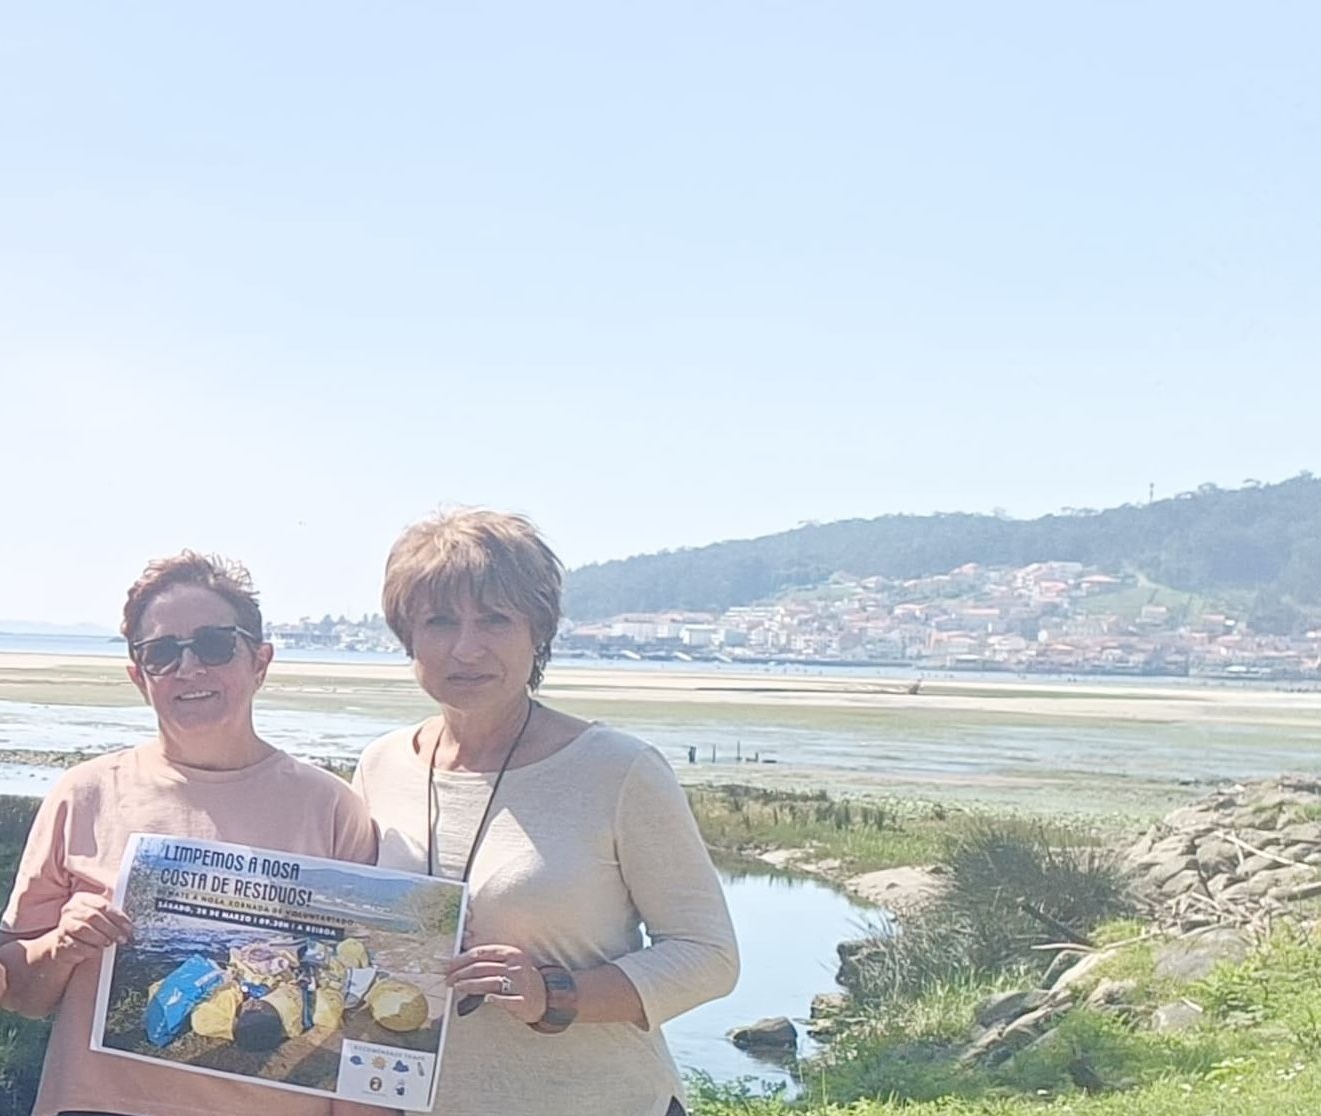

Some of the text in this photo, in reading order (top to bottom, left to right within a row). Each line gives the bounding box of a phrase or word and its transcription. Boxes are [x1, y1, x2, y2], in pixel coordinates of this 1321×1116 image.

[164, 845, 300, 880] LIMPEMOS A NOSA
[160, 868, 312, 907] COSTA DE RESIDUOS!
[209, 909, 220, 917] DE
[222, 911, 252, 922] MARZO
